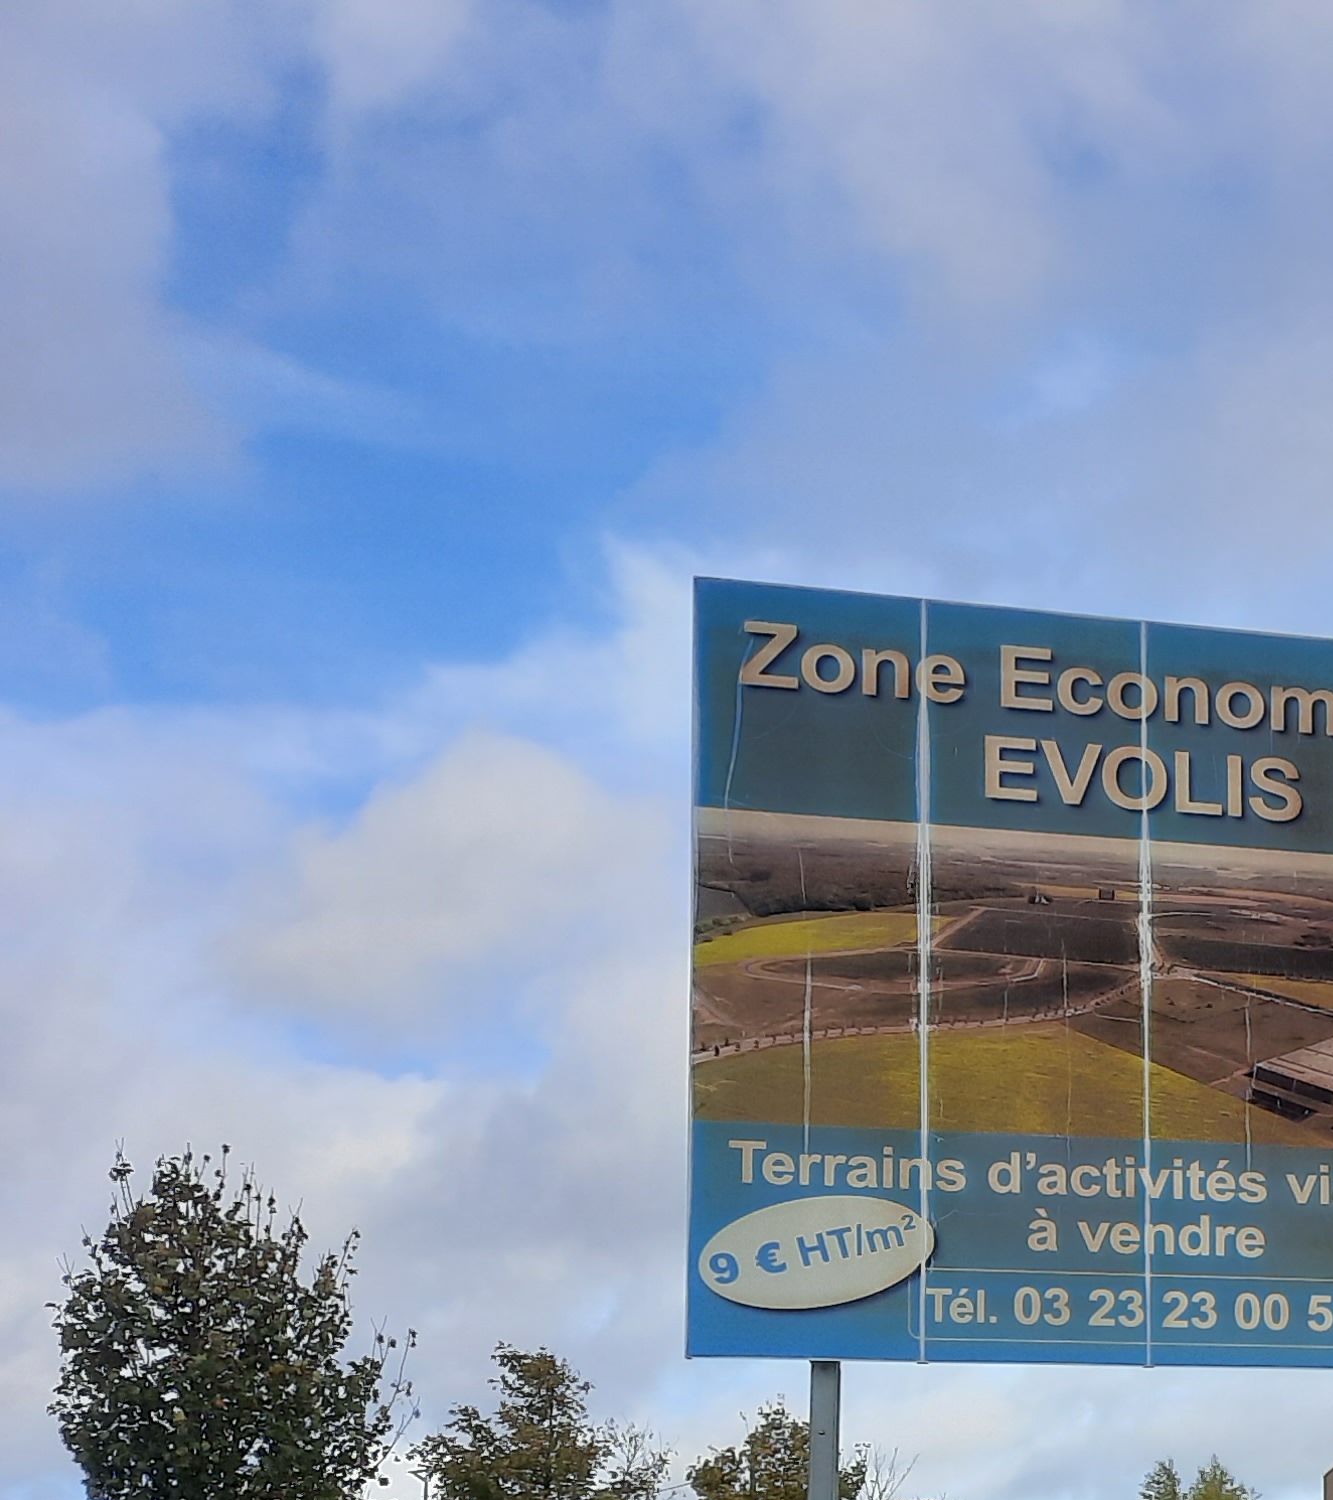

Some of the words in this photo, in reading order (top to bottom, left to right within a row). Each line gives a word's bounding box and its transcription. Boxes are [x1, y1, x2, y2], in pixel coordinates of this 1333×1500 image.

[738, 620, 966, 704] Zone
[983, 734, 1303, 823] EVOLIS
[728, 1139, 967, 1193] Terrains
[987, 1151, 1268, 1204] d’activités
[1027, 1207, 1058, 1252] à
[1077, 1214, 1266, 1258] vendre
[709, 1252, 740, 1284] 9
[754, 1241, 788, 1274] €
[926, 1287, 998, 1324] Tél.
[1013, 1286, 1071, 1326] 03
[1088, 1288, 1145, 1328] 23
[1161, 1290, 1218, 1330] 23
[1234, 1292, 1290, 1331] 00
